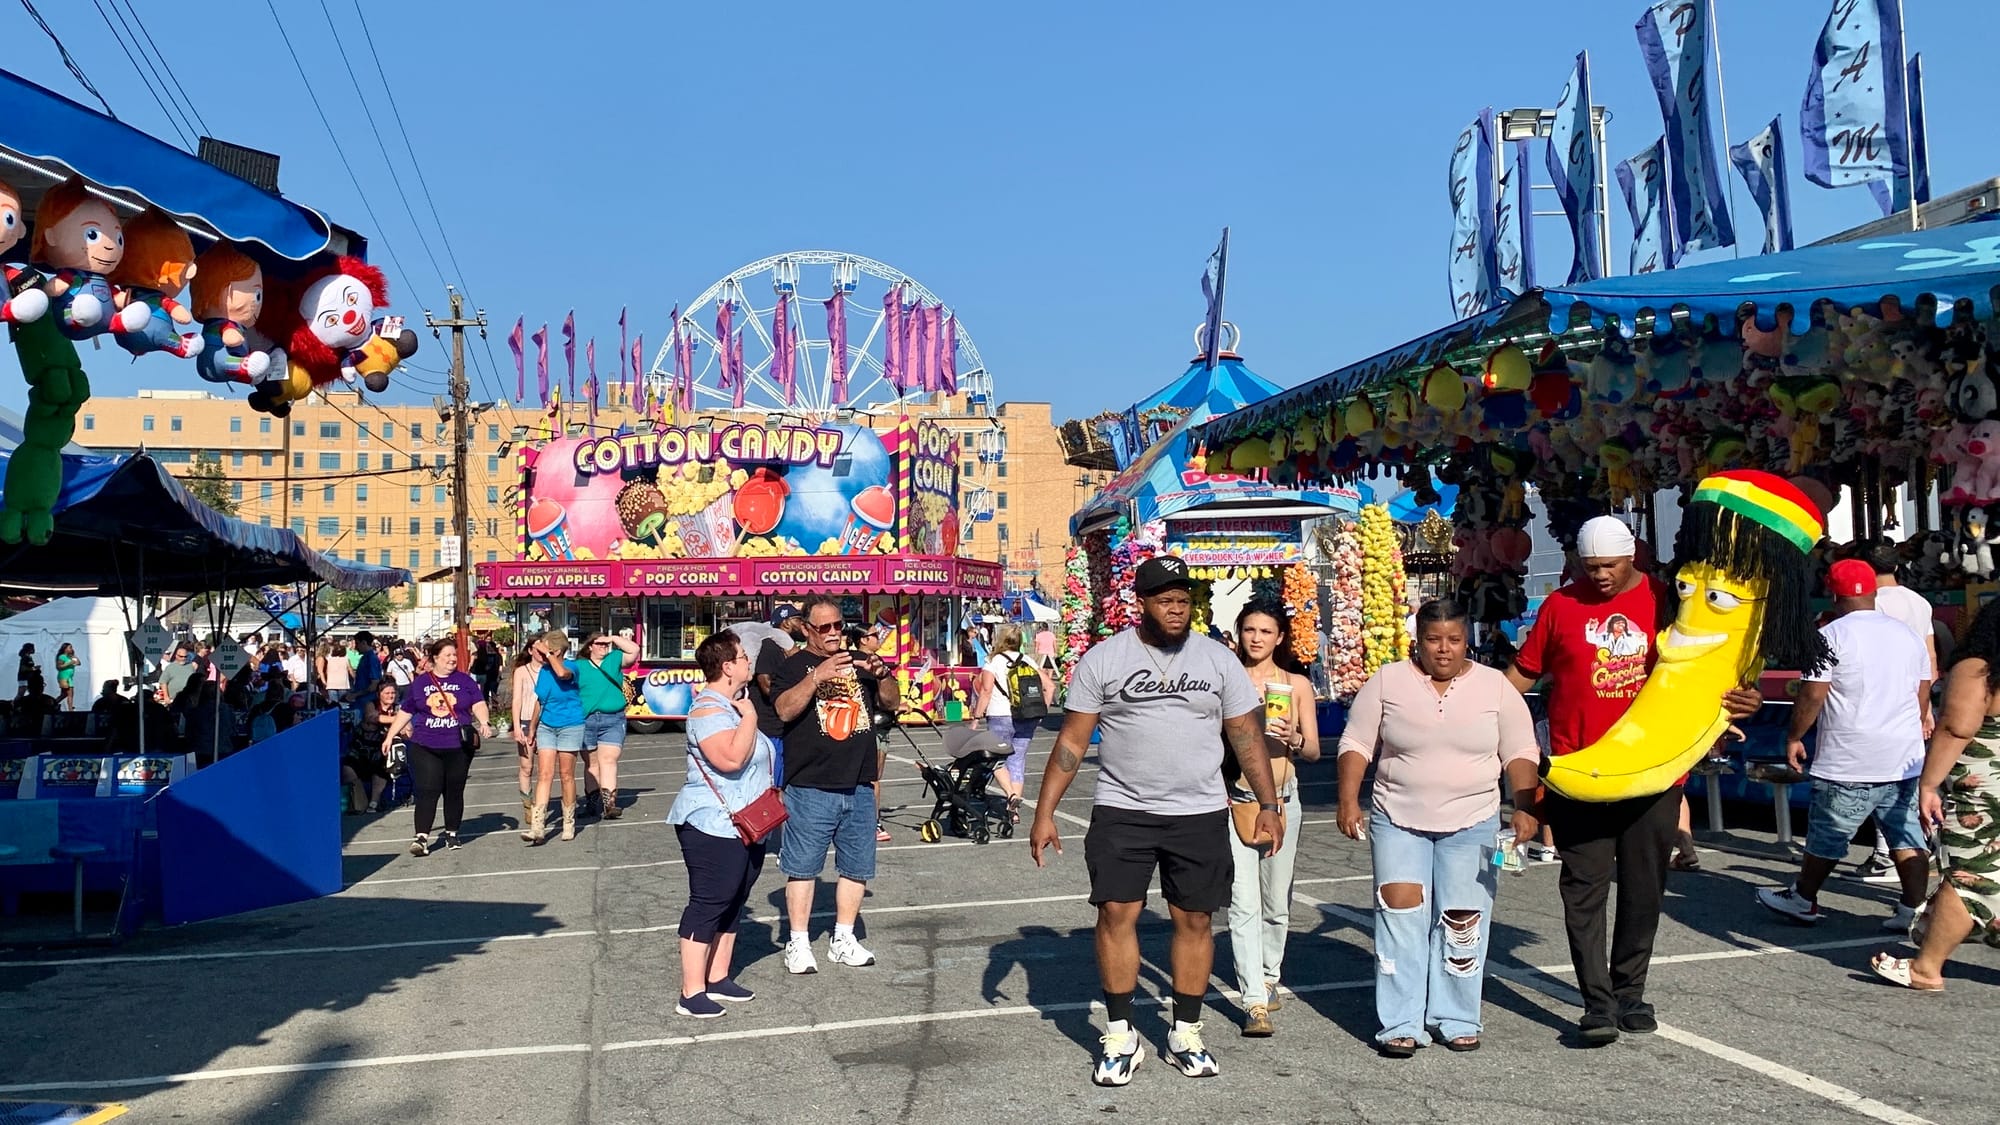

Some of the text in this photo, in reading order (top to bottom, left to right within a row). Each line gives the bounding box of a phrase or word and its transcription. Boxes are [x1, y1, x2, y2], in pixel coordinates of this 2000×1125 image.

[918, 421, 950, 459] POP
[575, 426, 842, 473] COTTON CANDY
[914, 459, 953, 496] CORN
[1173, 519, 1291, 532] PRIZE EVERYTIME
[843, 521, 877, 551] ICEE
[1188, 535, 1280, 550] DUCK POND
[543, 530, 573, 558] ICEE
[1184, 553, 1209, 561] EVERY
[1212, 553, 1233, 561] DUCK
[1253, 551, 1284, 561] WINNER
[507, 573, 606, 586] CANDY APPLES
[646, 572, 719, 585] POP CORN
[761, 570, 872, 583] COTTON CANDY
[894, 570, 949, 582] DRINKS
[963, 573, 991, 586] POP CORN
[649, 669, 704, 687] COTTON
[1592, 663, 1646, 689] Chocolat
[1596, 690, 1623, 698] World
[425, 718, 459, 728] mama
